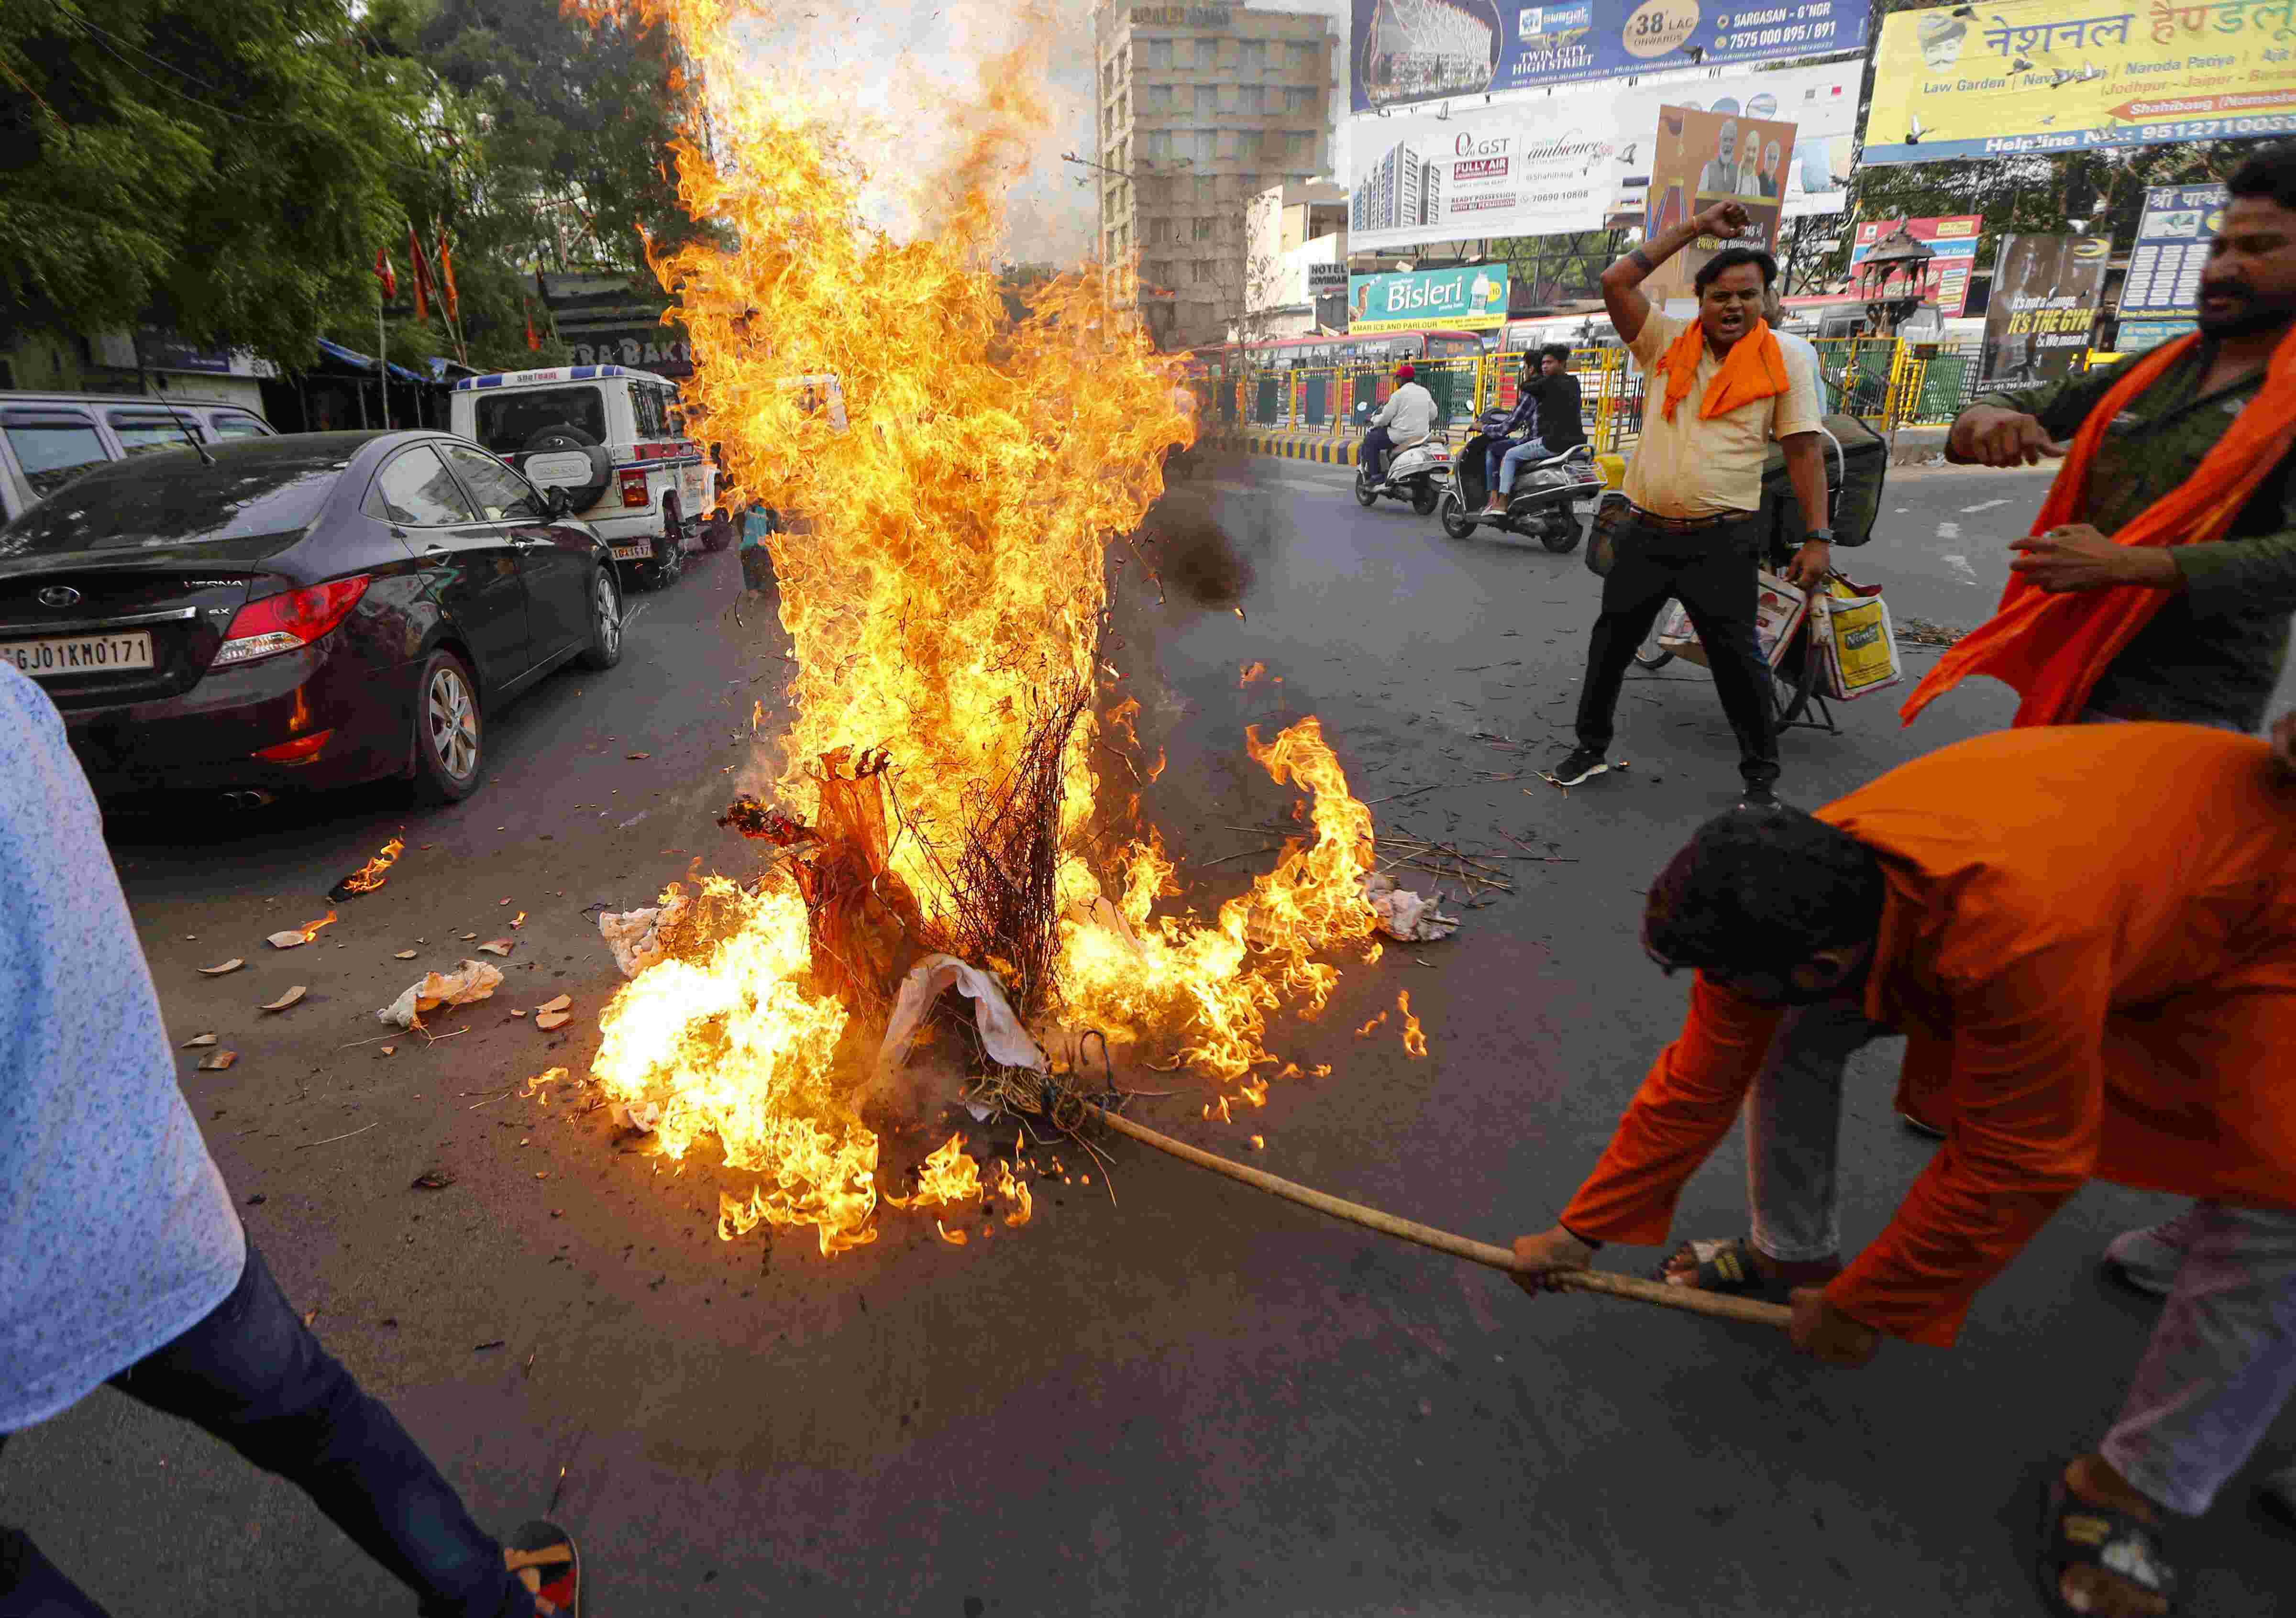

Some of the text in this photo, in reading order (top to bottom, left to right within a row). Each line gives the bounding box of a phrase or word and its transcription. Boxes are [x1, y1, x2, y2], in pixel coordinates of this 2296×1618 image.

[1730, 31, 1759, 49] 7575
[1760, 28, 1781, 45] 000
[1983, 14, 2135, 58] नेशनल
[1520, 44, 1587, 63] TWIN CITY
[1512, 54, 1594, 76] HIGH STREET
[1923, 82, 1952, 93] Law
[1956, 78, 2005, 91] Garden
[2125, 60, 2181, 75] Naroda
[2130, 99, 2213, 115] Shahibaug
[1478, 137, 1510, 154] GST
[1456, 158, 1506, 173] FULLY AIR
[1451, 191, 1516, 204] READY POSSESSION
[1533, 192, 1559, 203] 70690
[1387, 275, 1463, 312] Bisleri
[1352, 324, 1372, 332] AMAR
[1403, 321, 1438, 329] PARLOUR
[2032, 310, 2063, 333] THE
[2059, 308, 2097, 331] GYM
[2036, 332, 2045, 348] &
[2058, 335, 2081, 347] mean
[16, 638, 146, 670] GJ01KM0171
